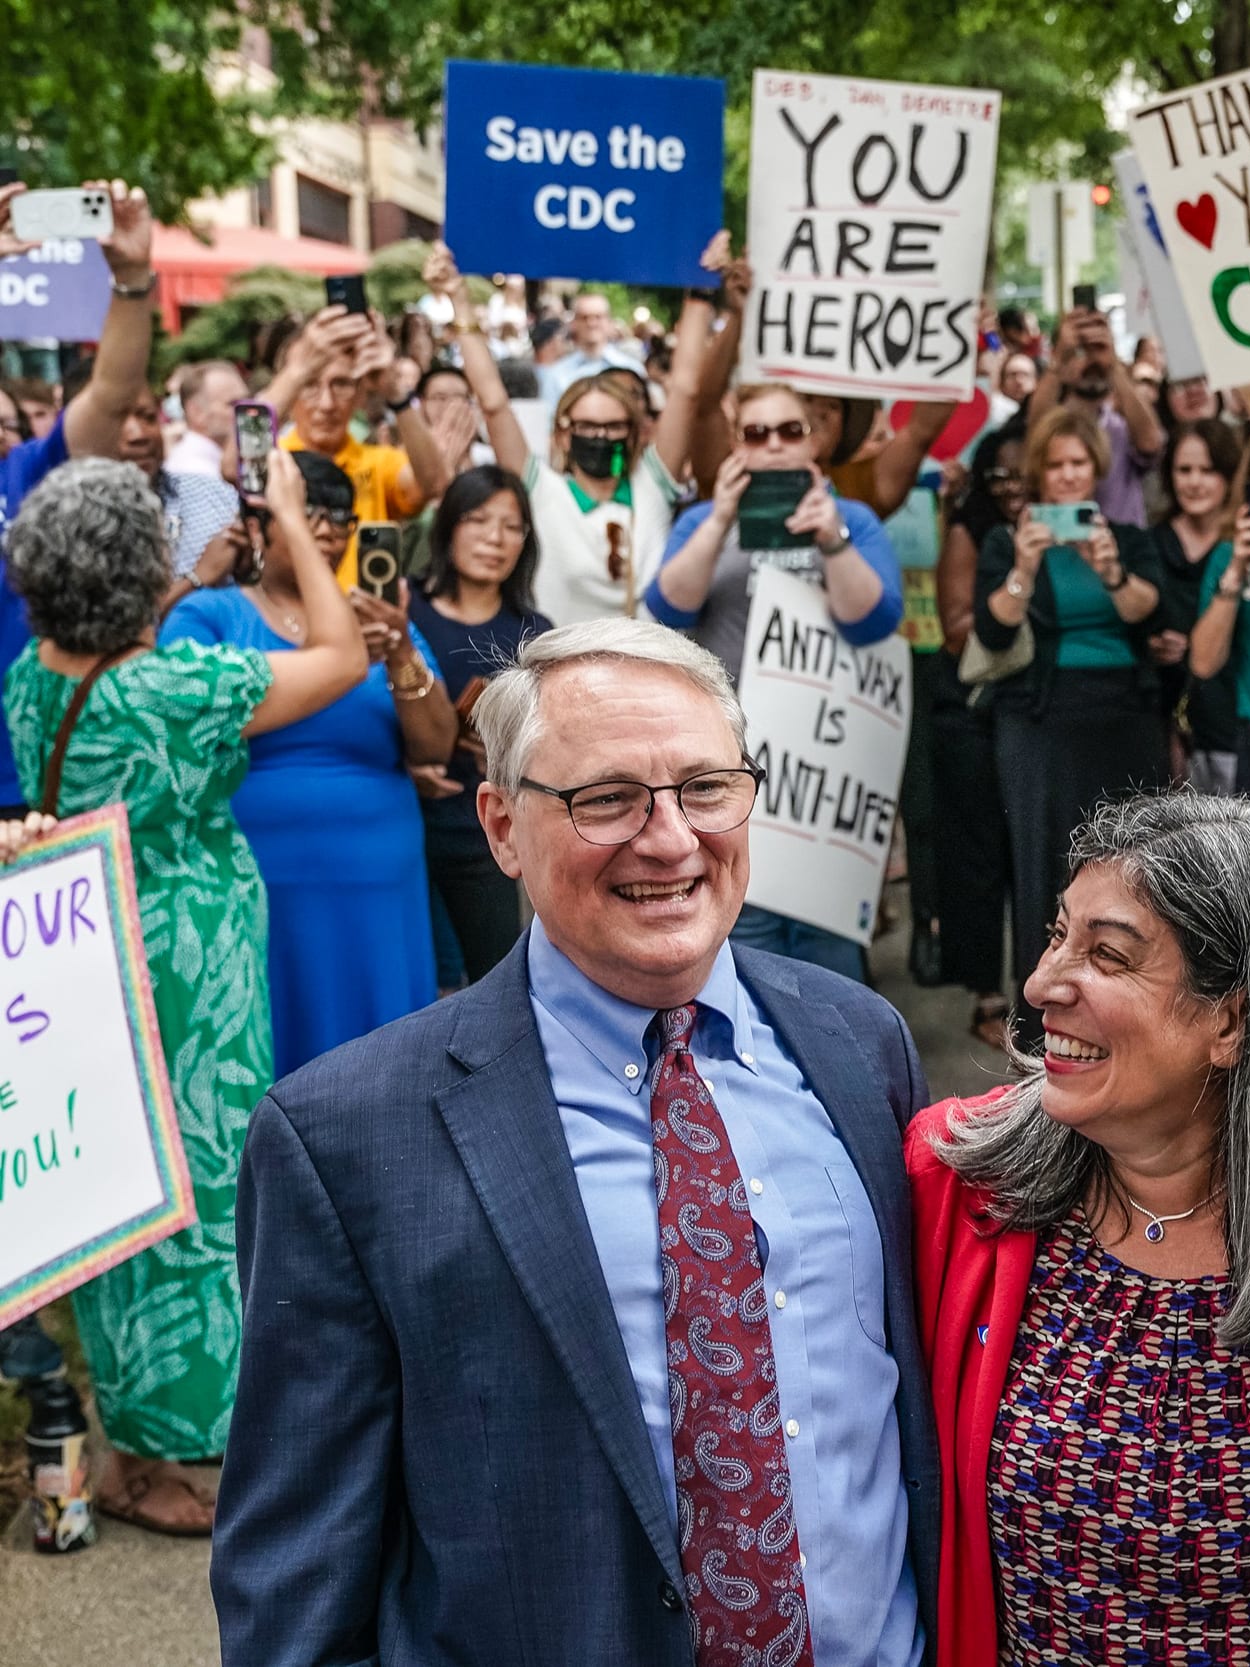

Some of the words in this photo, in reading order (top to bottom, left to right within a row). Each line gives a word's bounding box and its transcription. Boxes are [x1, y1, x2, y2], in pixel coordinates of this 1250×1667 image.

[485, 115, 599, 168] Save
[608, 124, 686, 173] the
[779, 107, 968, 208] YOU
[534, 184, 637, 234] CDC
[779, 217, 943, 279] ARE
[757, 289, 978, 378] HEROES
[758, 606, 904, 714] ANTI-VAX
[814, 698, 846, 745] IS
[2, 877, 96, 959] OUR
